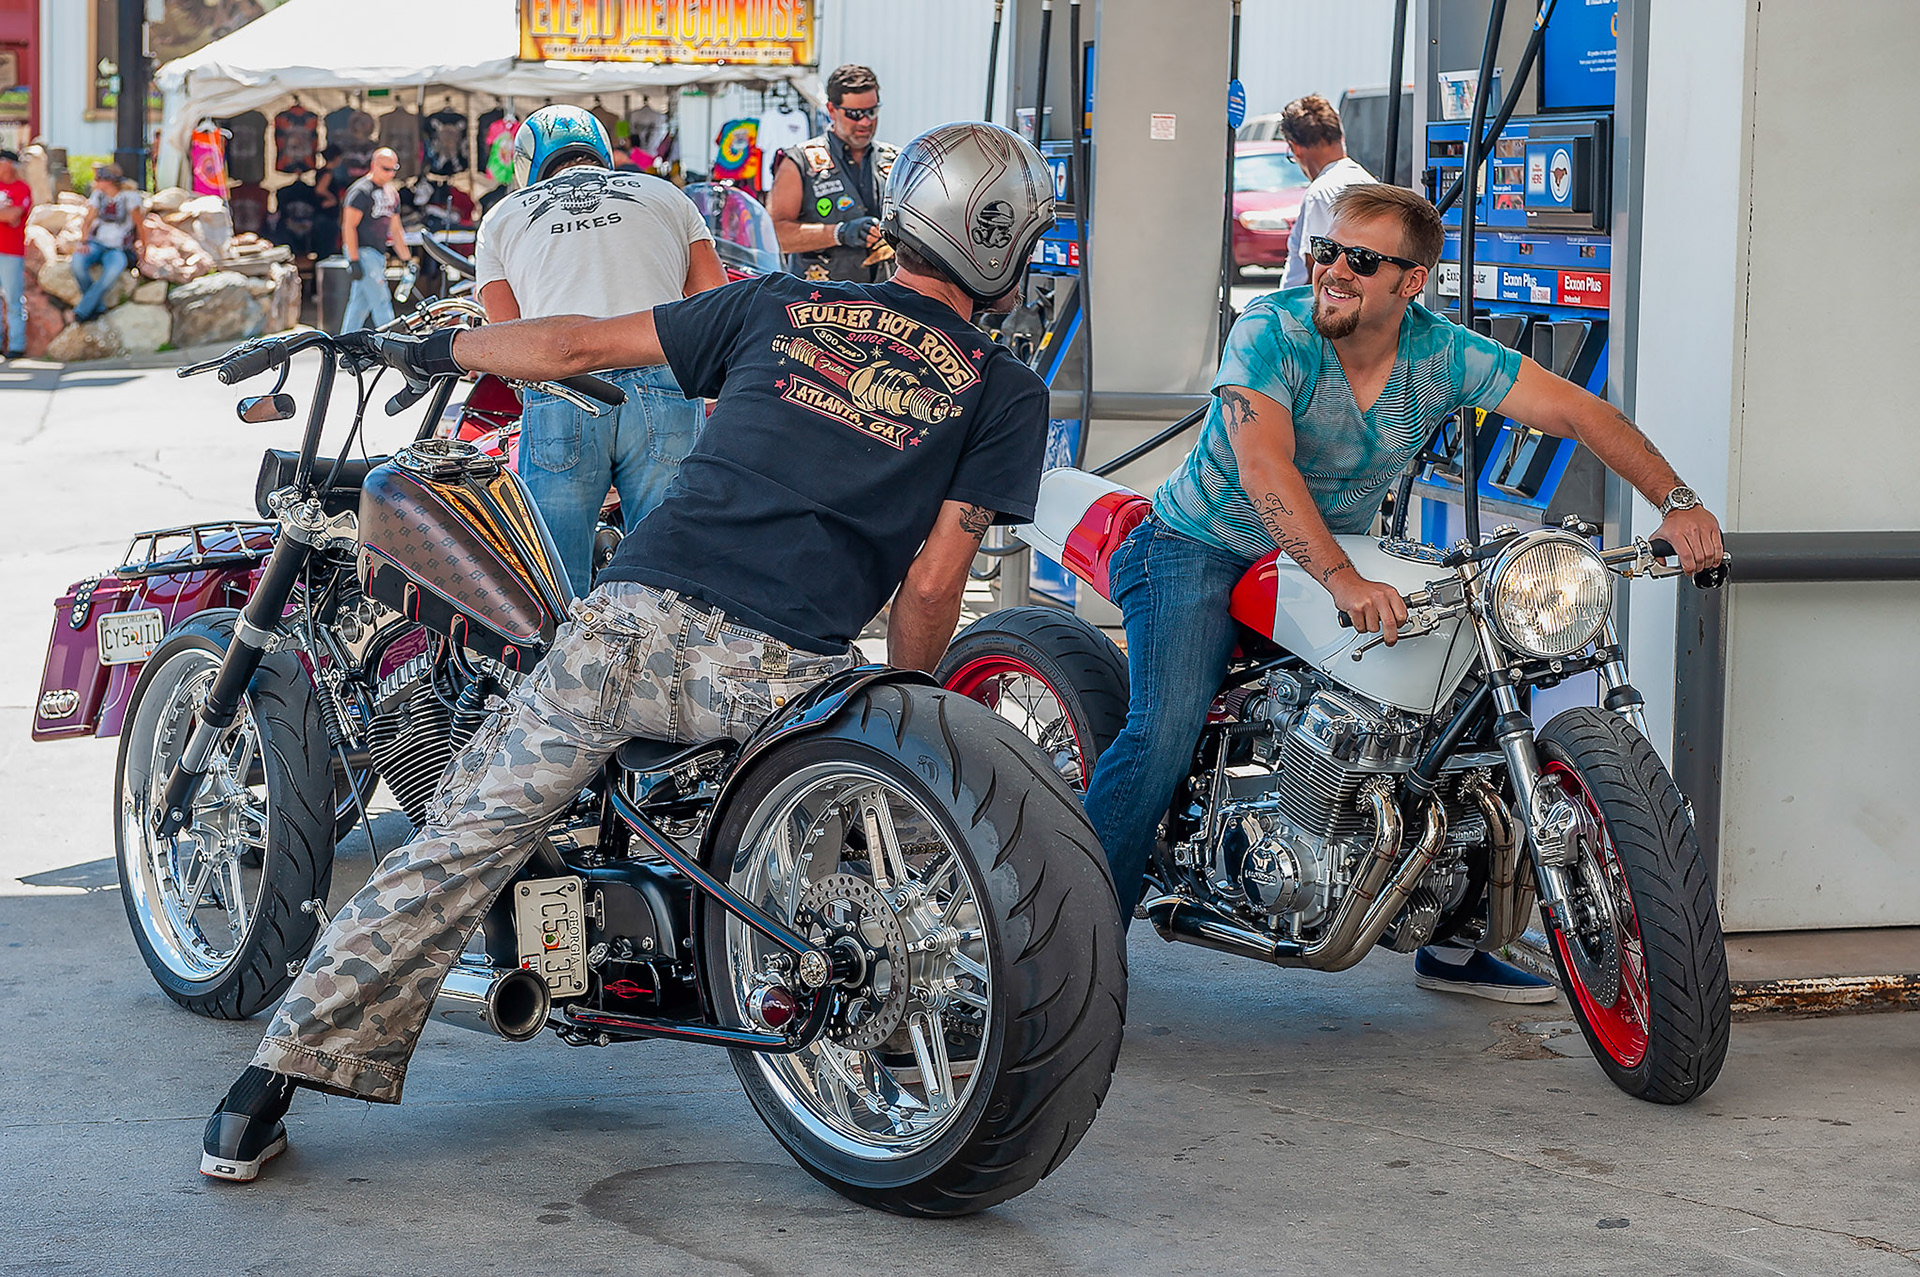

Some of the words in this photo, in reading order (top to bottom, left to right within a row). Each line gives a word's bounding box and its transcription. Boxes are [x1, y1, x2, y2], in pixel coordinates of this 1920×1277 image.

[550, 212, 623, 235] BIKES
[1503, 271, 1522, 287] Exxon
[1564, 275, 1586, 292] Exxon
[1586, 276, 1602, 293] Plus
[797, 306, 874, 330] FULLER
[876, 311, 920, 340] HOT
[918, 332, 971, 387] RODS
[846, 332, 887, 345] SINCE
[888, 341, 920, 362] 2002
[795, 385, 864, 426] ATLANTA,
[868, 421, 896, 439] GA
